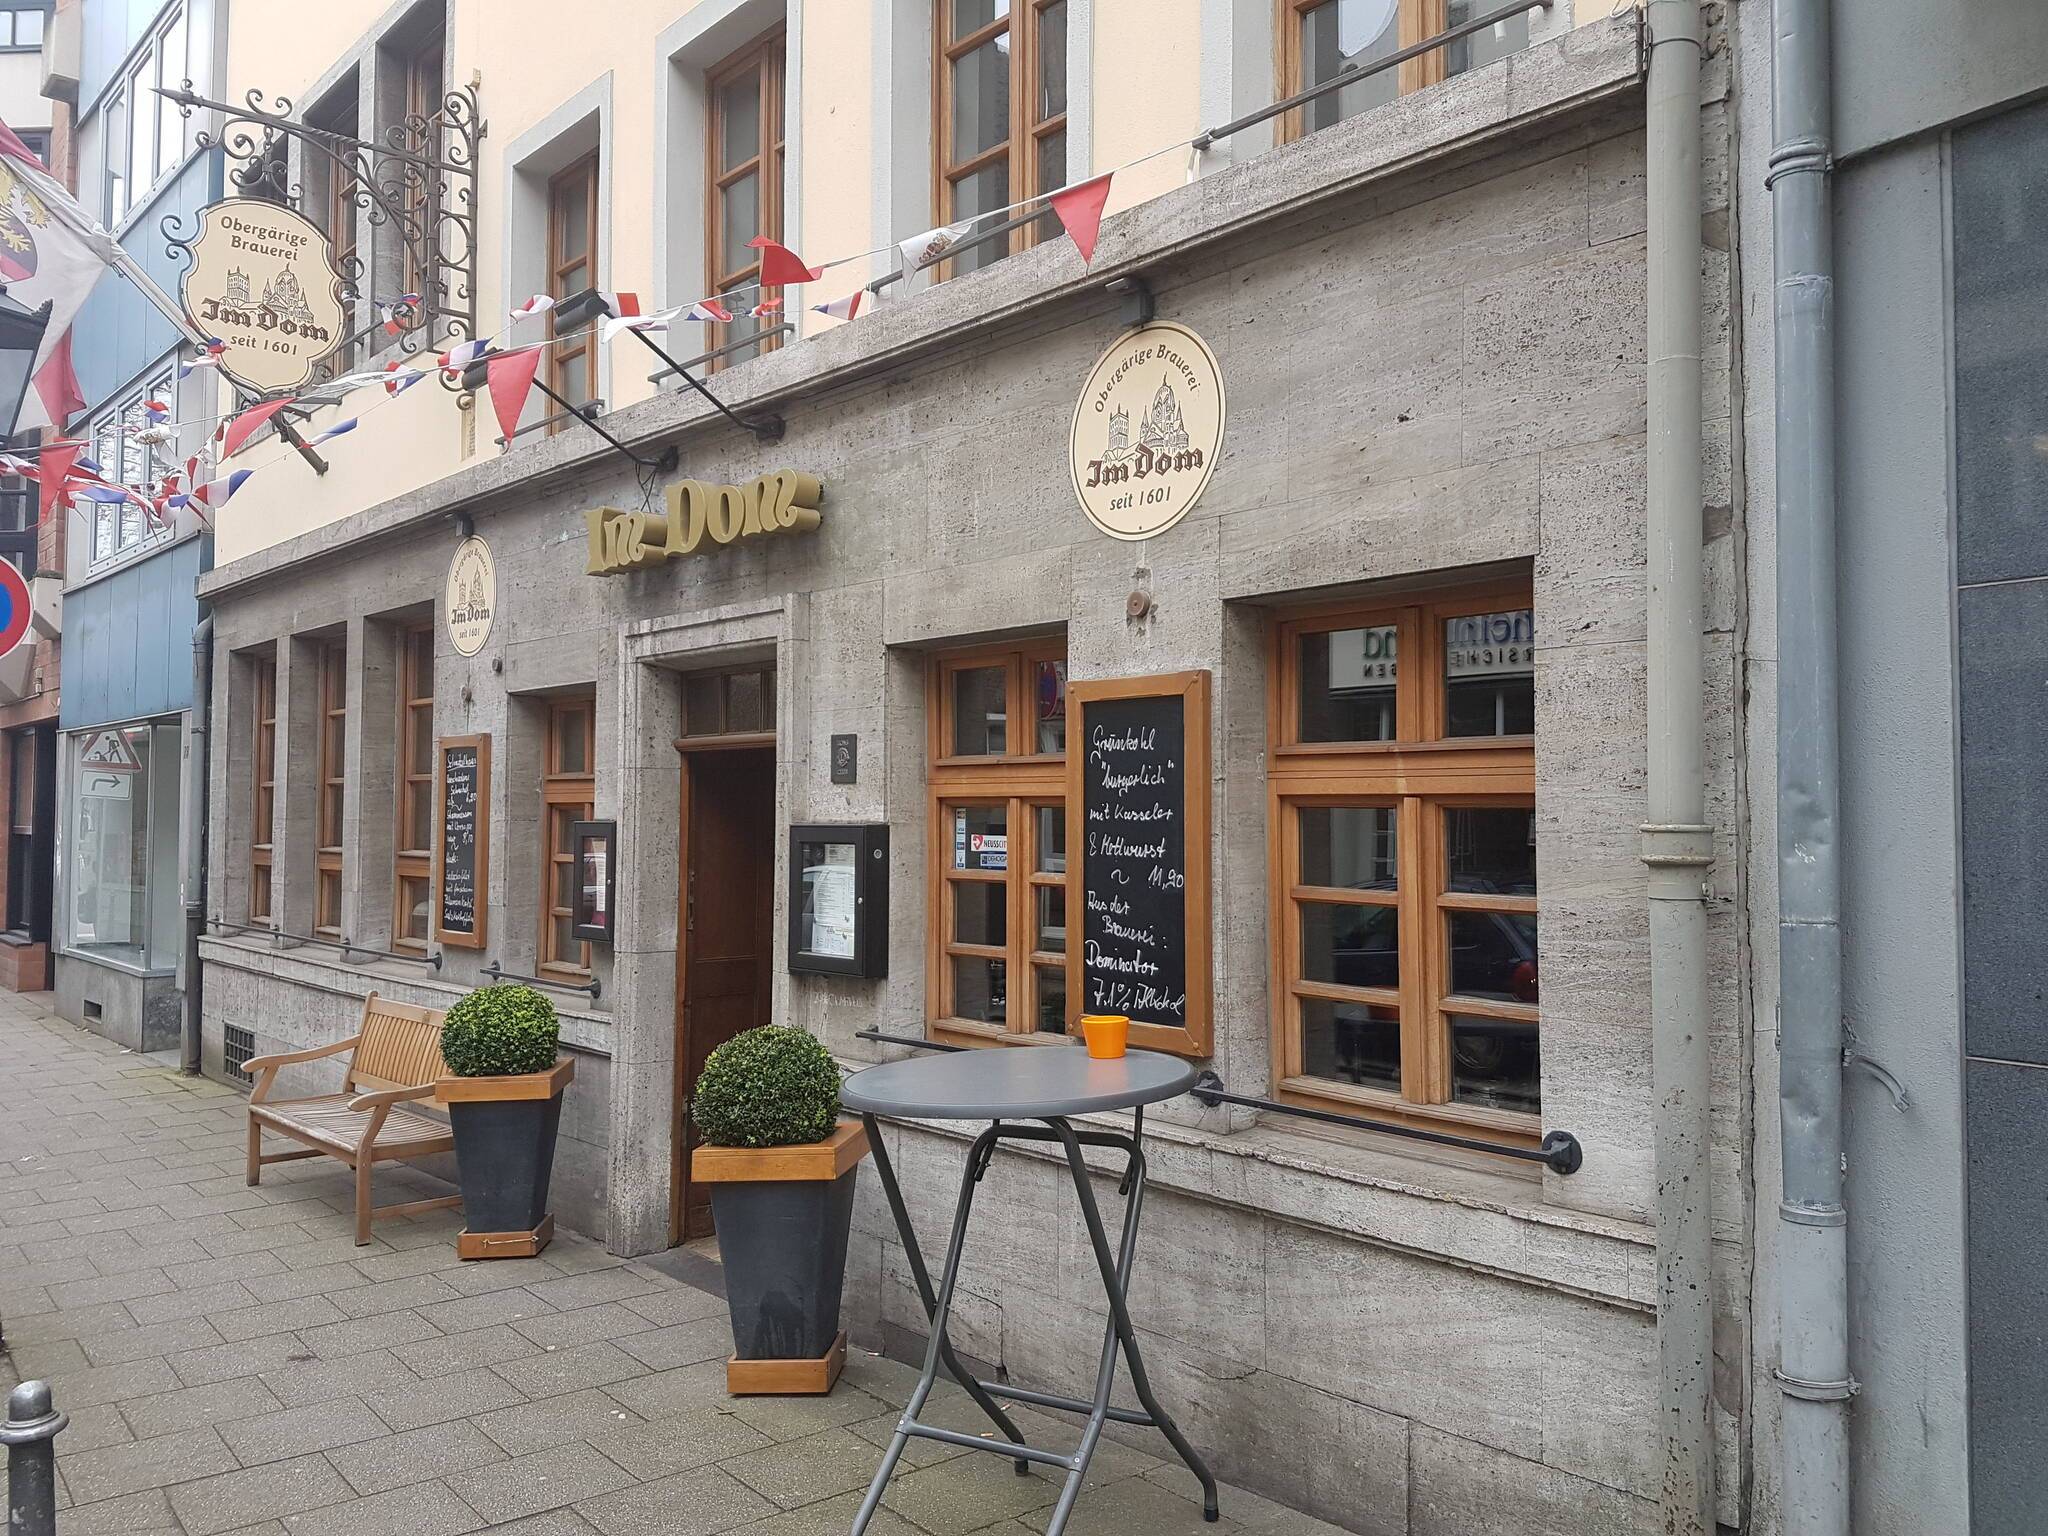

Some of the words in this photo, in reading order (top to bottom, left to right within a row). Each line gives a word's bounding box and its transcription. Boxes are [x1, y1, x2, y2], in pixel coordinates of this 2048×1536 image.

[221, 216, 308, 247] Obergärige
[231, 235, 298, 261] Brauerei
[201, 297, 251, 328] Im
[256, 303, 329, 343] Dom
[231, 335, 256, 348] seit
[263, 339, 297, 355] 1601
[1095, 348, 1153, 413] Obergärige
[1156, 344, 1201, 391] Brauerei
[1086, 460, 1129, 488] Im
[1133, 442, 1204, 480] Dom
[1109, 493, 1133, 511] seit
[1139, 486, 1171, 506] 1601
[584, 505, 655, 576] Im
[664, 467, 815, 556] Dom
[451, 608, 466, 625] Im
[467, 602, 490, 622] Dom
[1089, 802, 1110, 821] mit
[1113, 802, 1174, 821] Kasseler
[1100, 833, 1167, 858] Mettwurst
[1088, 890, 1108, 911] Aus
[1109, 895, 1130, 915] der
[1085, 939, 1159, 976] Dominator
